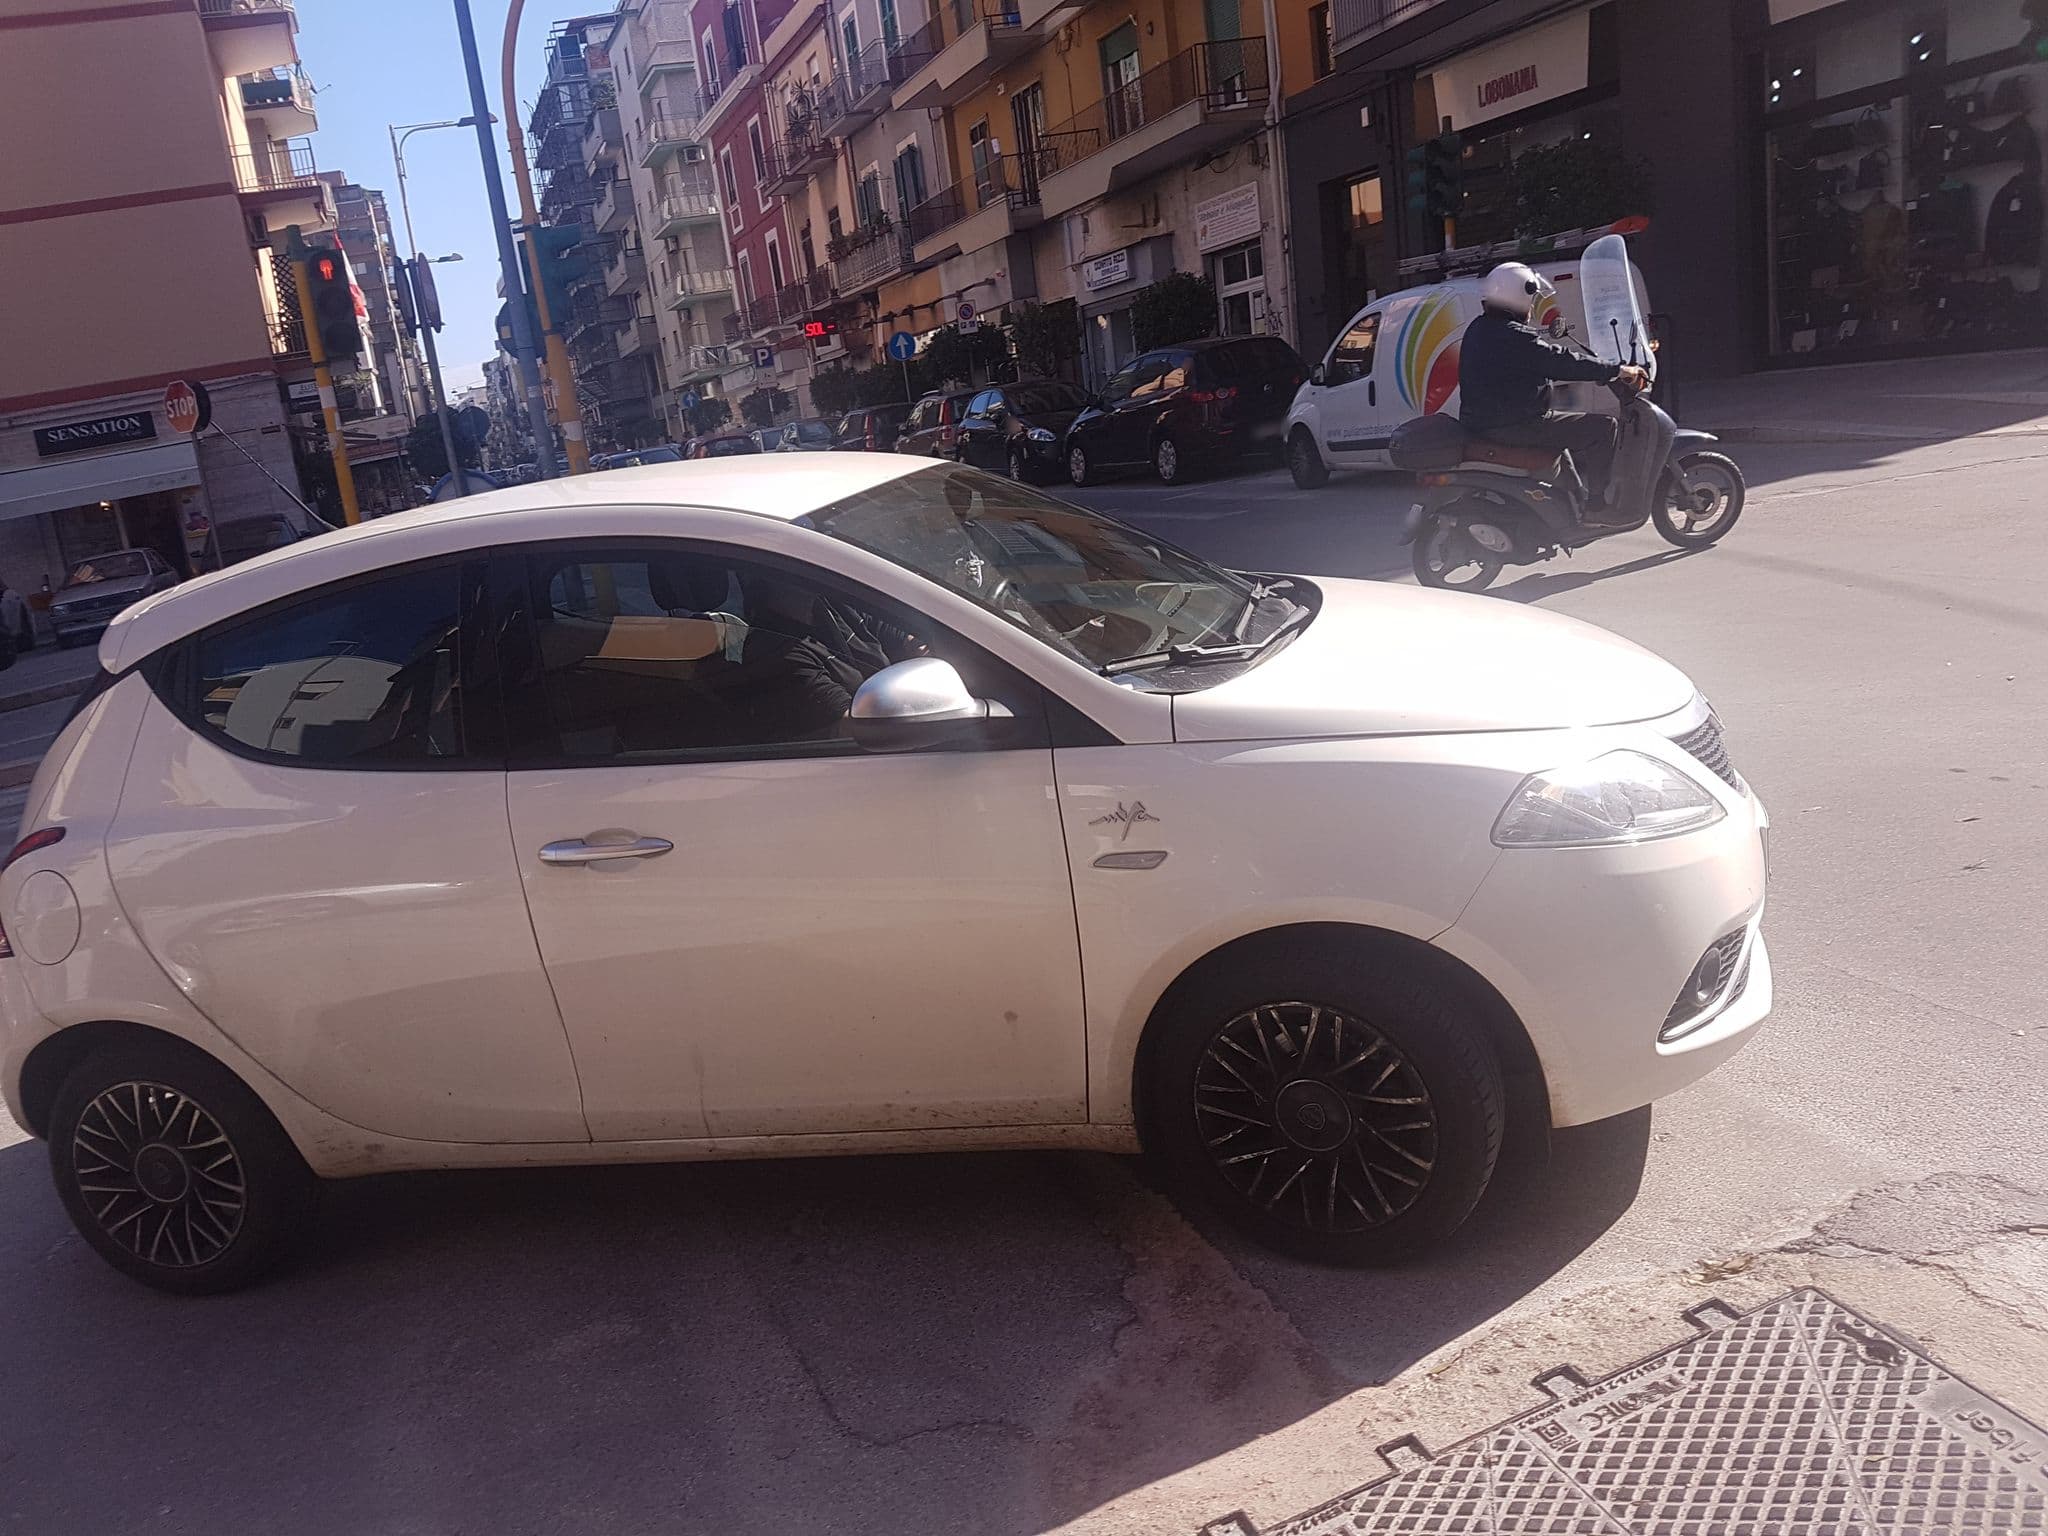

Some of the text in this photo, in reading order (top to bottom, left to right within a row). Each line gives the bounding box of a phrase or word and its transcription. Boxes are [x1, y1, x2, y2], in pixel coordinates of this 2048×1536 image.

[757, 348, 769, 366] P
[166, 396, 195, 418] STOP
[47, 416, 141, 443] SENSATION
